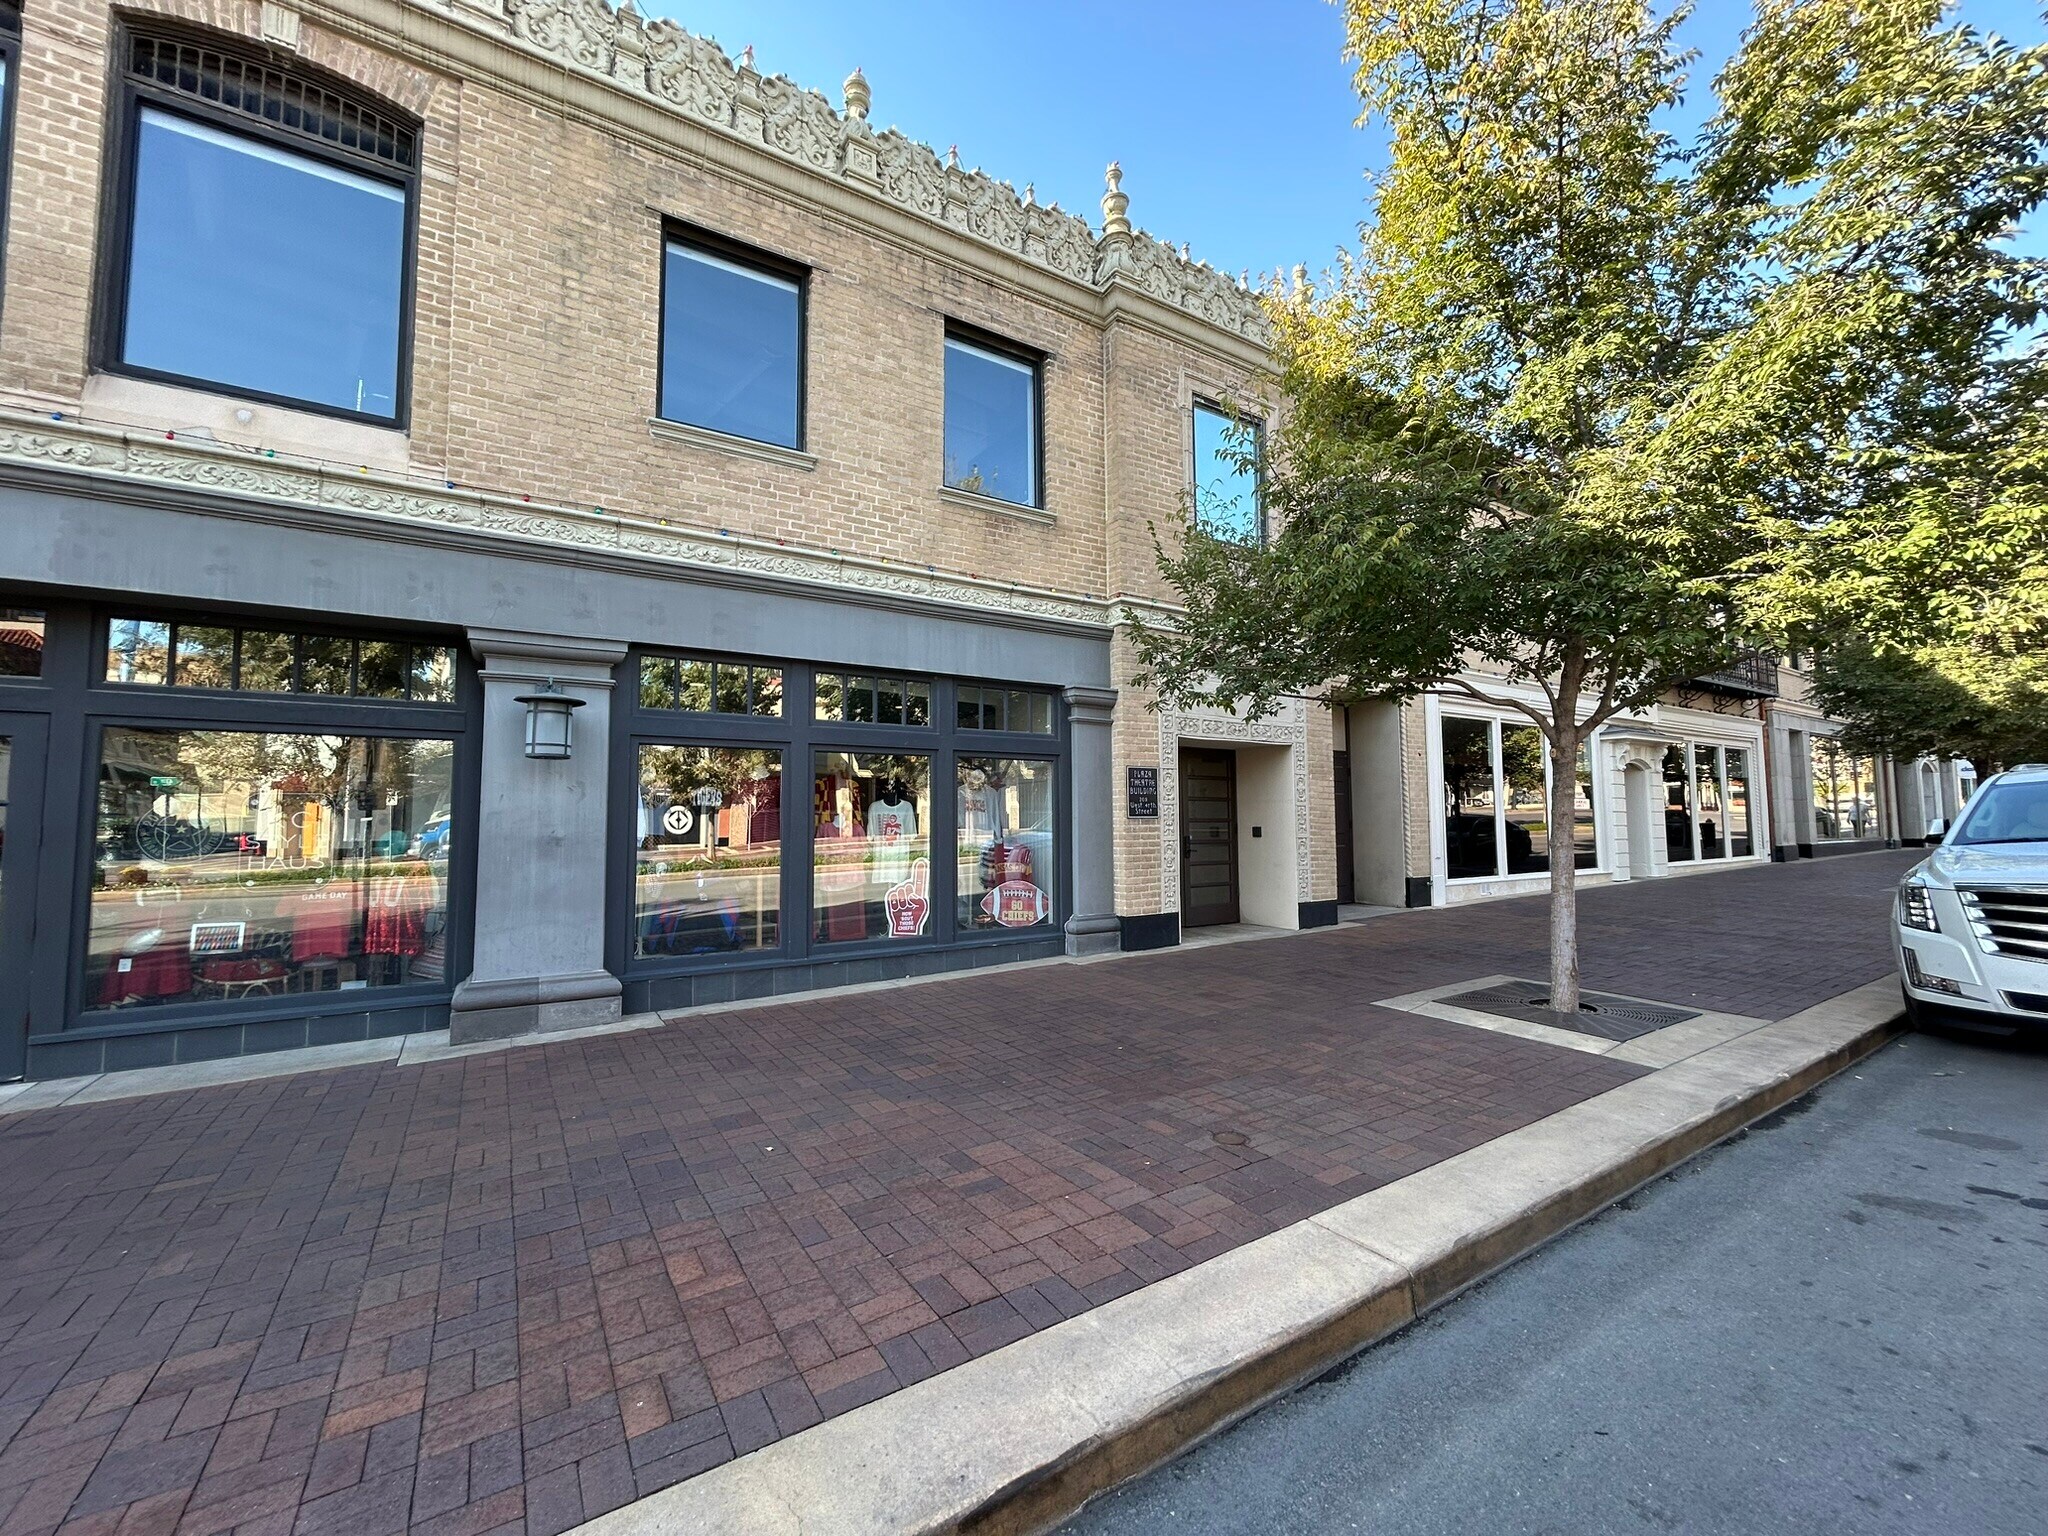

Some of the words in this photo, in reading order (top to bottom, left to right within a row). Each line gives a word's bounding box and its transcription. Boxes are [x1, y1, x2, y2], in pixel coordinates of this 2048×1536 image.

[1130, 787, 1157, 795] BUILDING
[248, 855, 325, 870] HAUS
[301, 893, 327, 901] GAME
[1011, 900, 1023, 910] GO
[1002, 910, 1035, 921] CHIEFS
